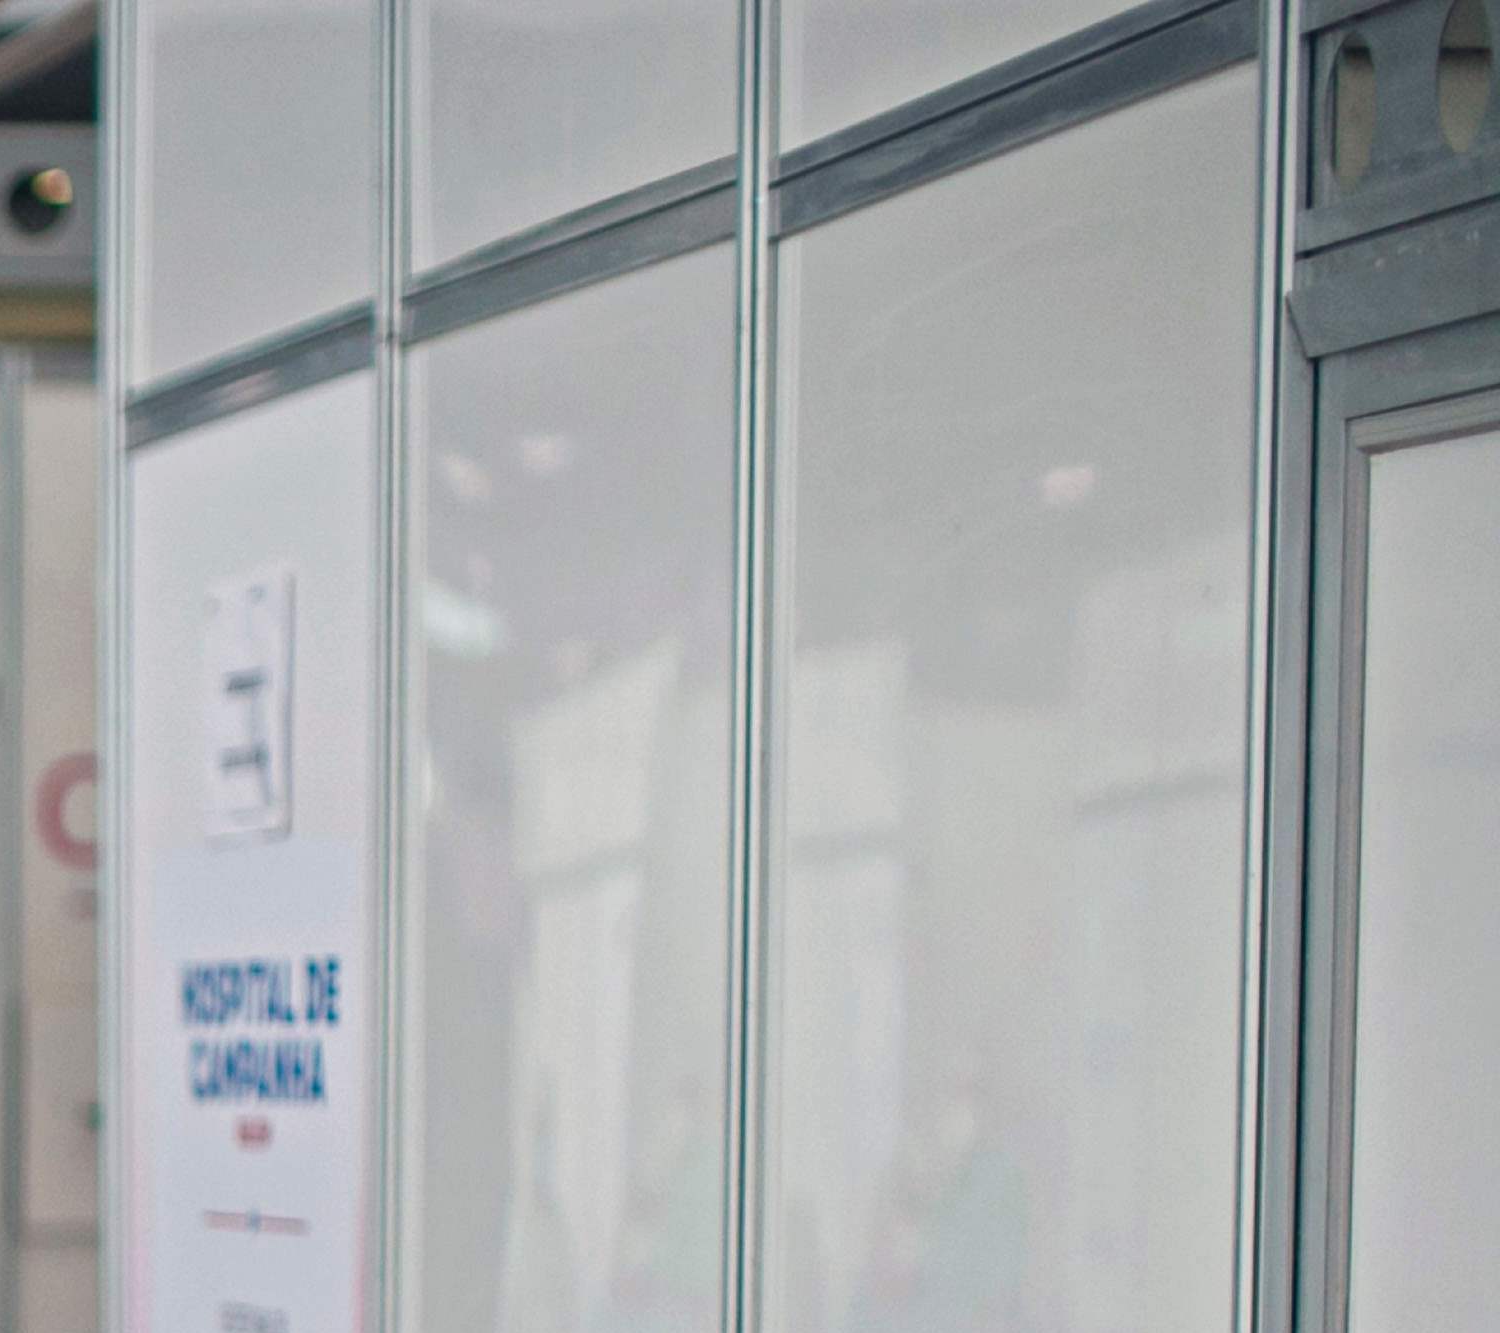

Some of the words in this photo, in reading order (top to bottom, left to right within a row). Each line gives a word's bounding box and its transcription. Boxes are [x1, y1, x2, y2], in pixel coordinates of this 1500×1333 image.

[181, 961, 295, 1024] HOSPITAL
[305, 955, 340, 1023] DE
[190, 1040, 325, 1102] CAMPANHA
